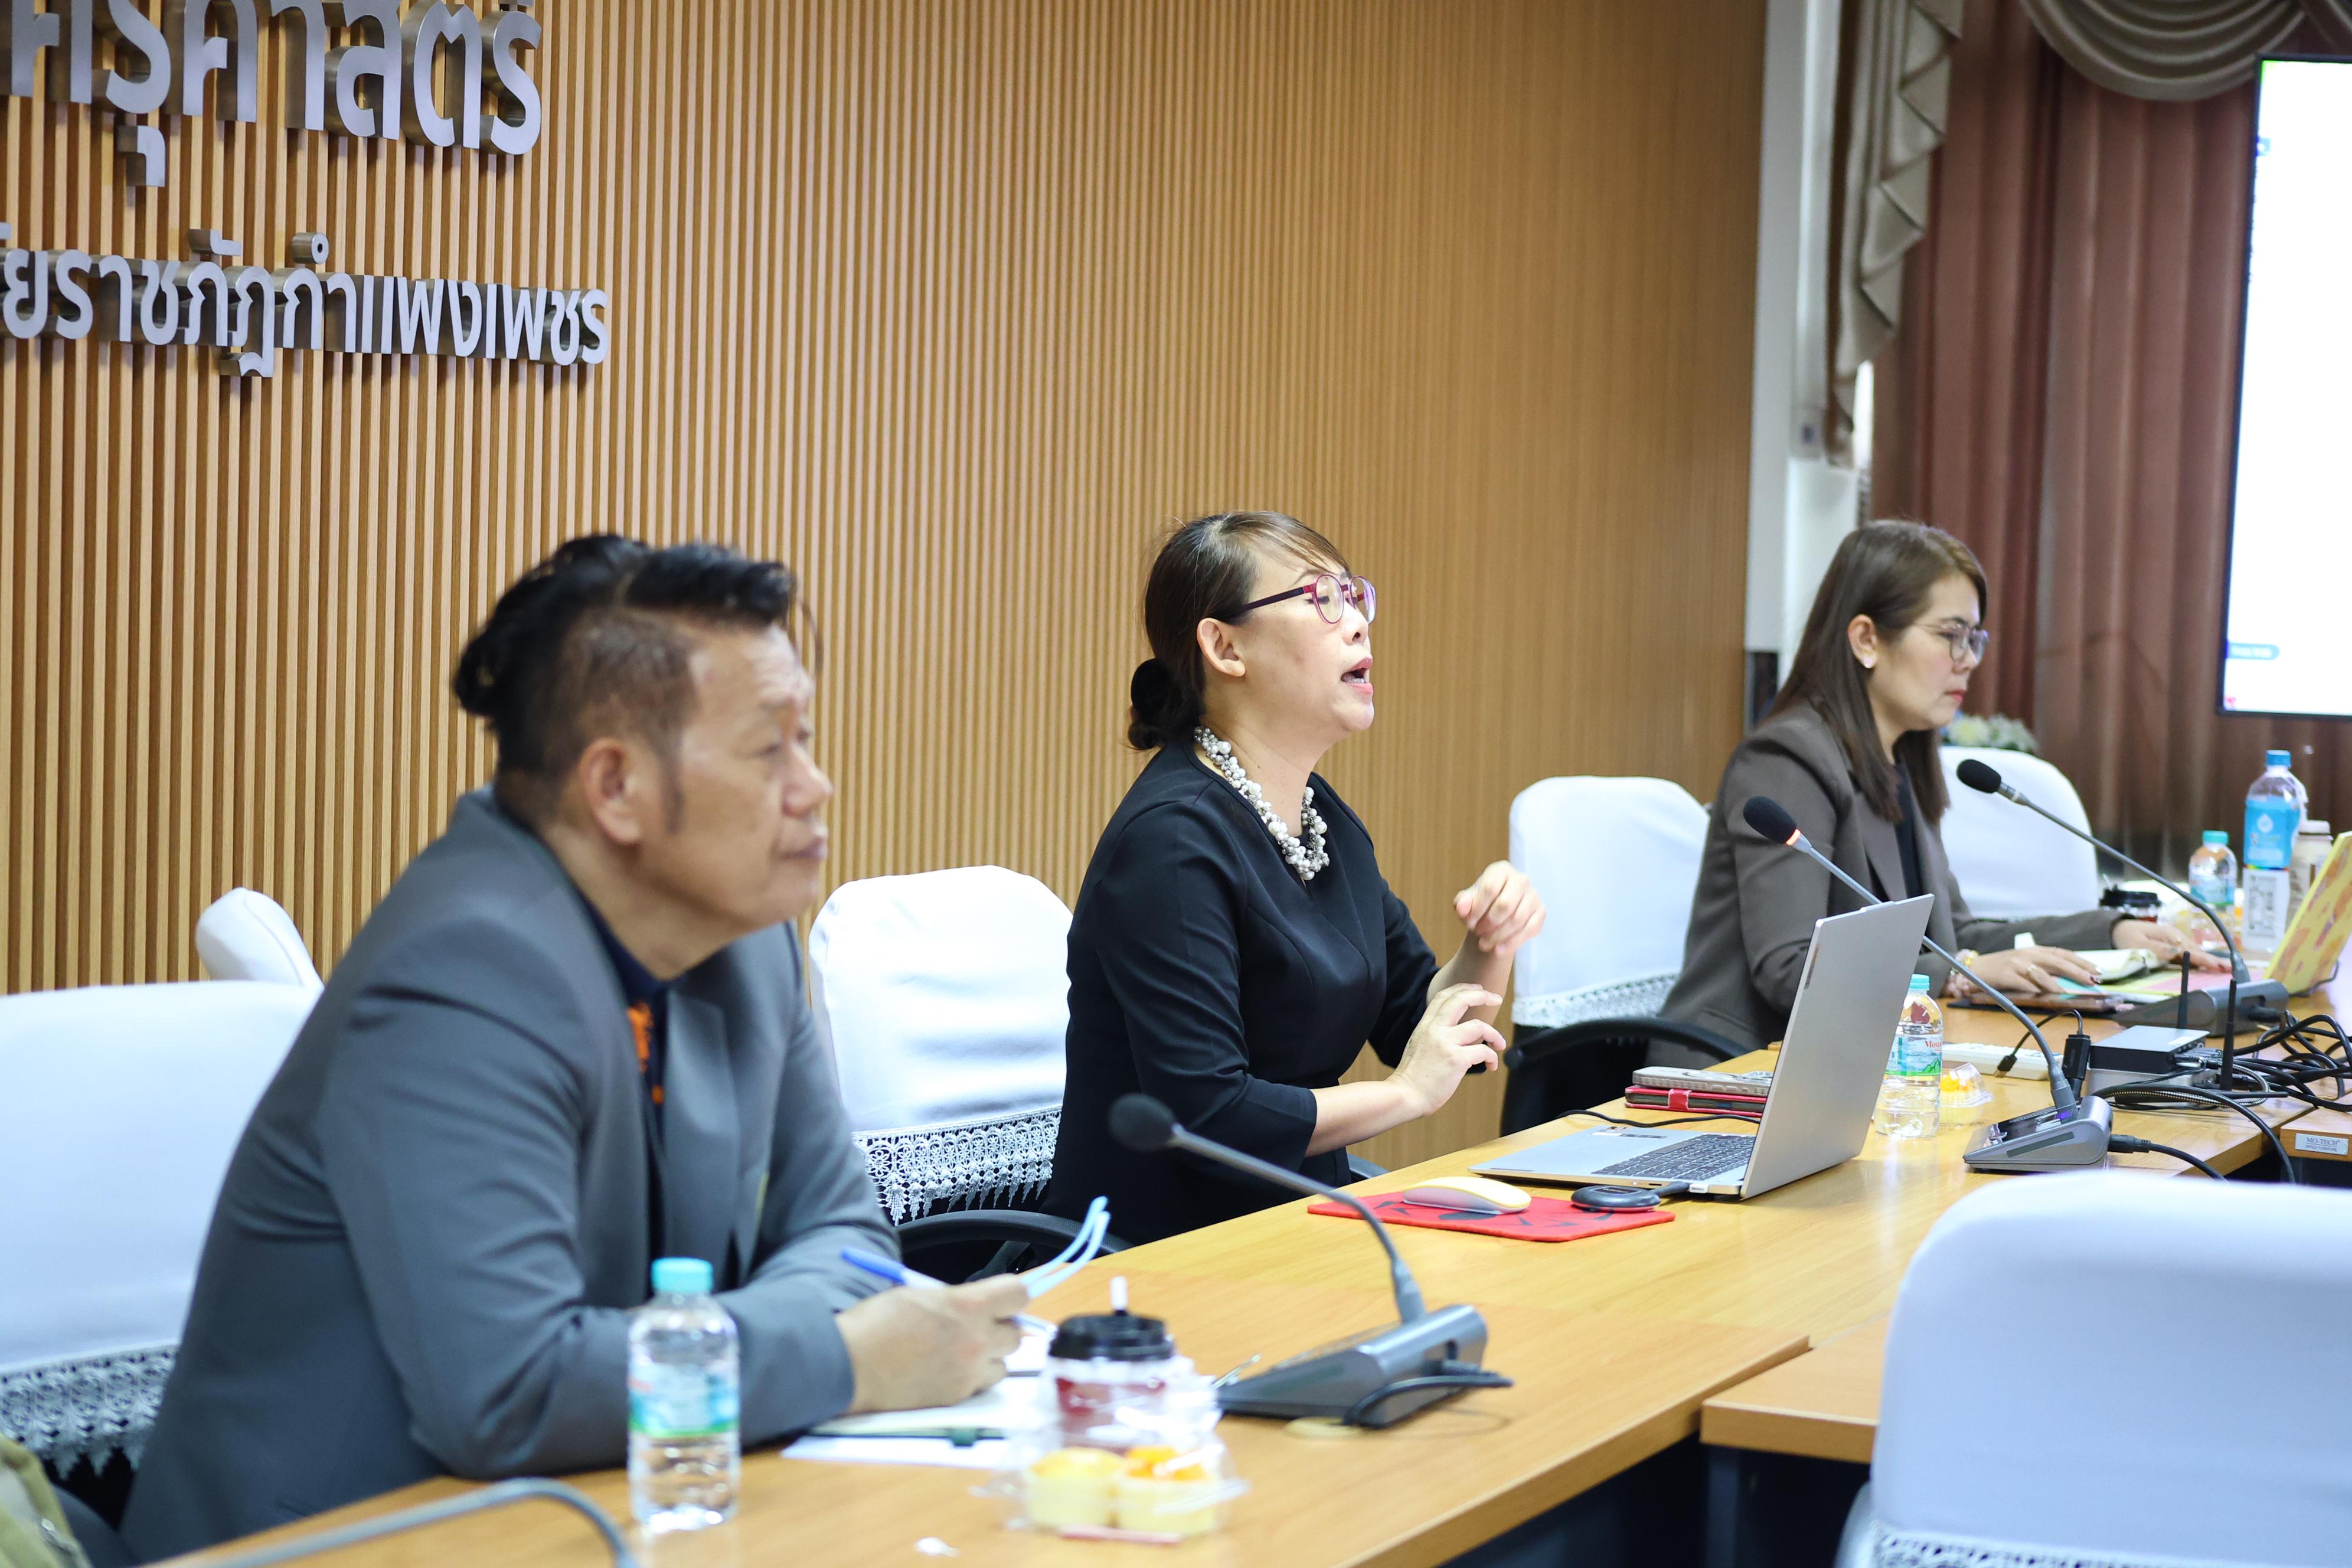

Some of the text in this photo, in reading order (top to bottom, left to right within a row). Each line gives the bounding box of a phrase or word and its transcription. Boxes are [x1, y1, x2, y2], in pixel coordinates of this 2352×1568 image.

[11, 0, 542, 188] ครุศาสตร
[0, 223, 609, 378] ยราชภัฏกำแพงเพชร
